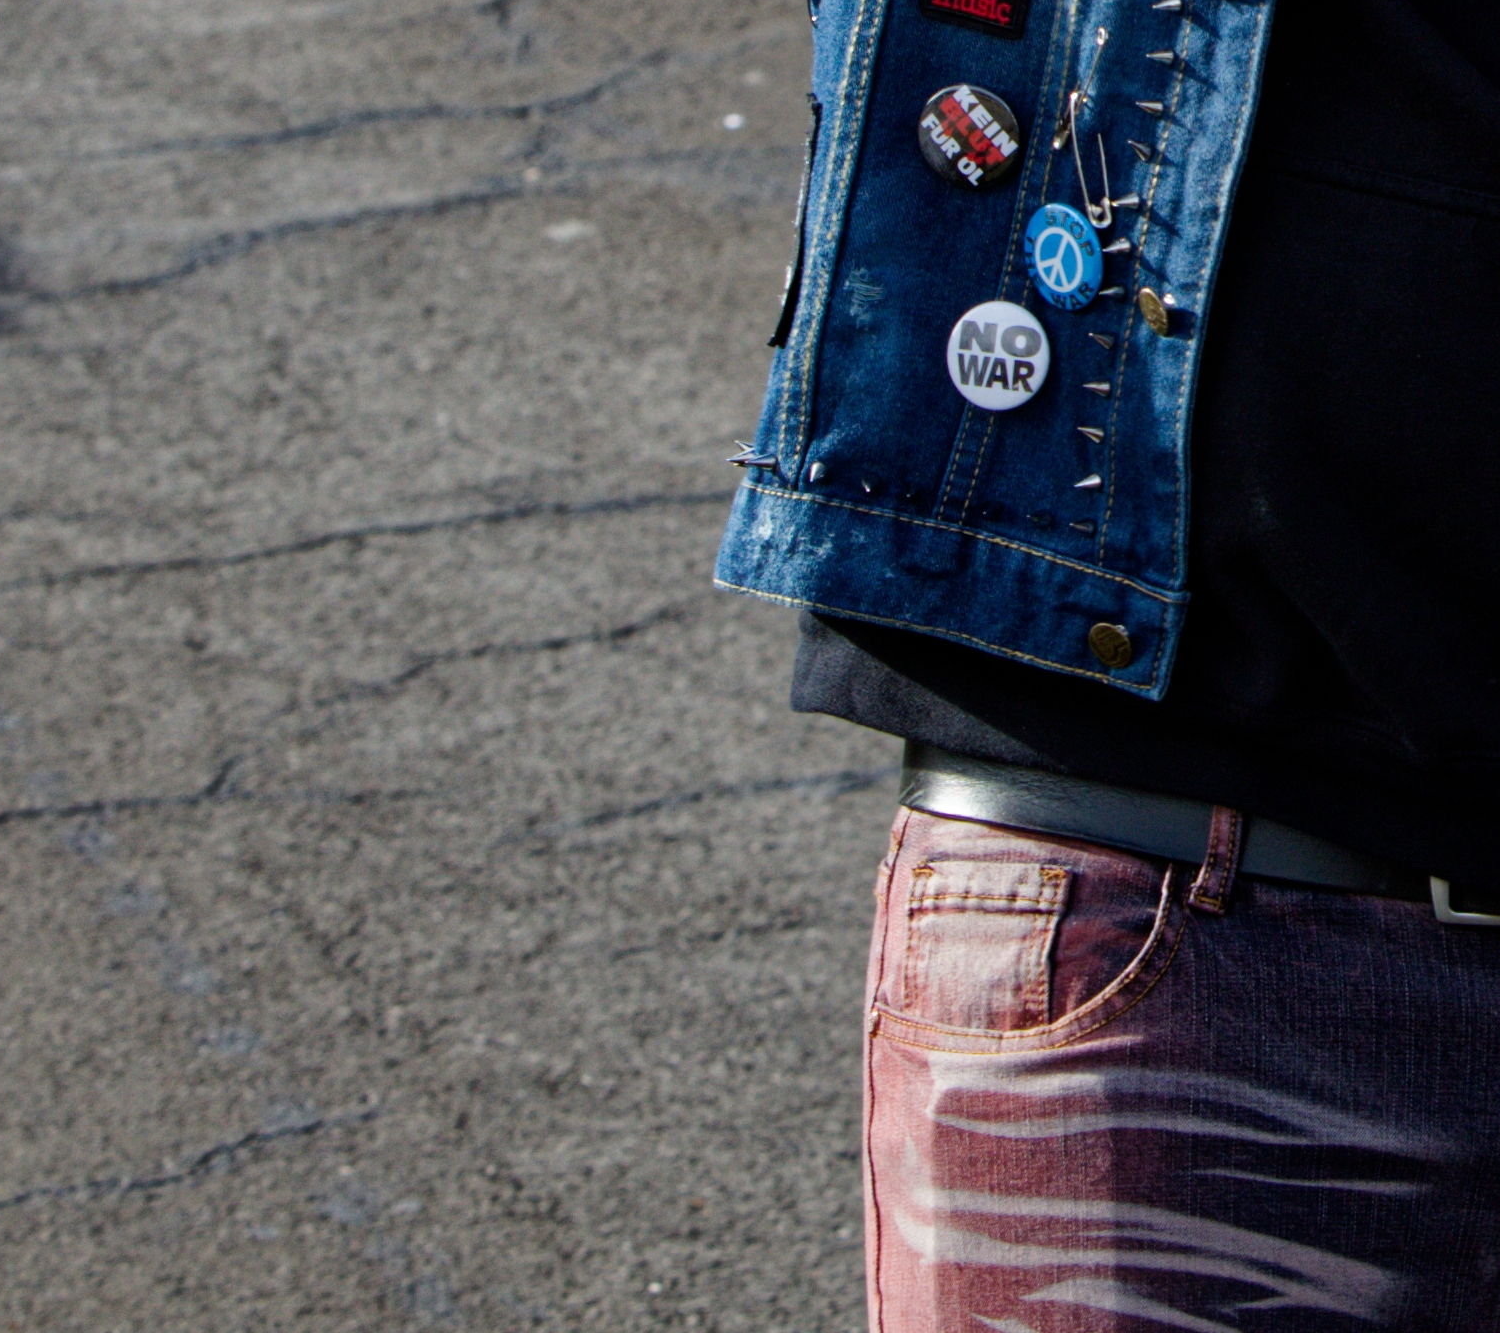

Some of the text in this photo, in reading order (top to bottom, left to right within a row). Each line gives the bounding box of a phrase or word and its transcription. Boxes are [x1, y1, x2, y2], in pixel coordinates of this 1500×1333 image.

[939, 96, 1006, 166] BLUT
[953, 85, 1019, 158] KEIN
[1045, 209, 1094, 257] STOP
[1051, 281, 1094, 310] WAR
[959, 320, 1042, 358] NO
[957, 353, 1035, 393] WAR
